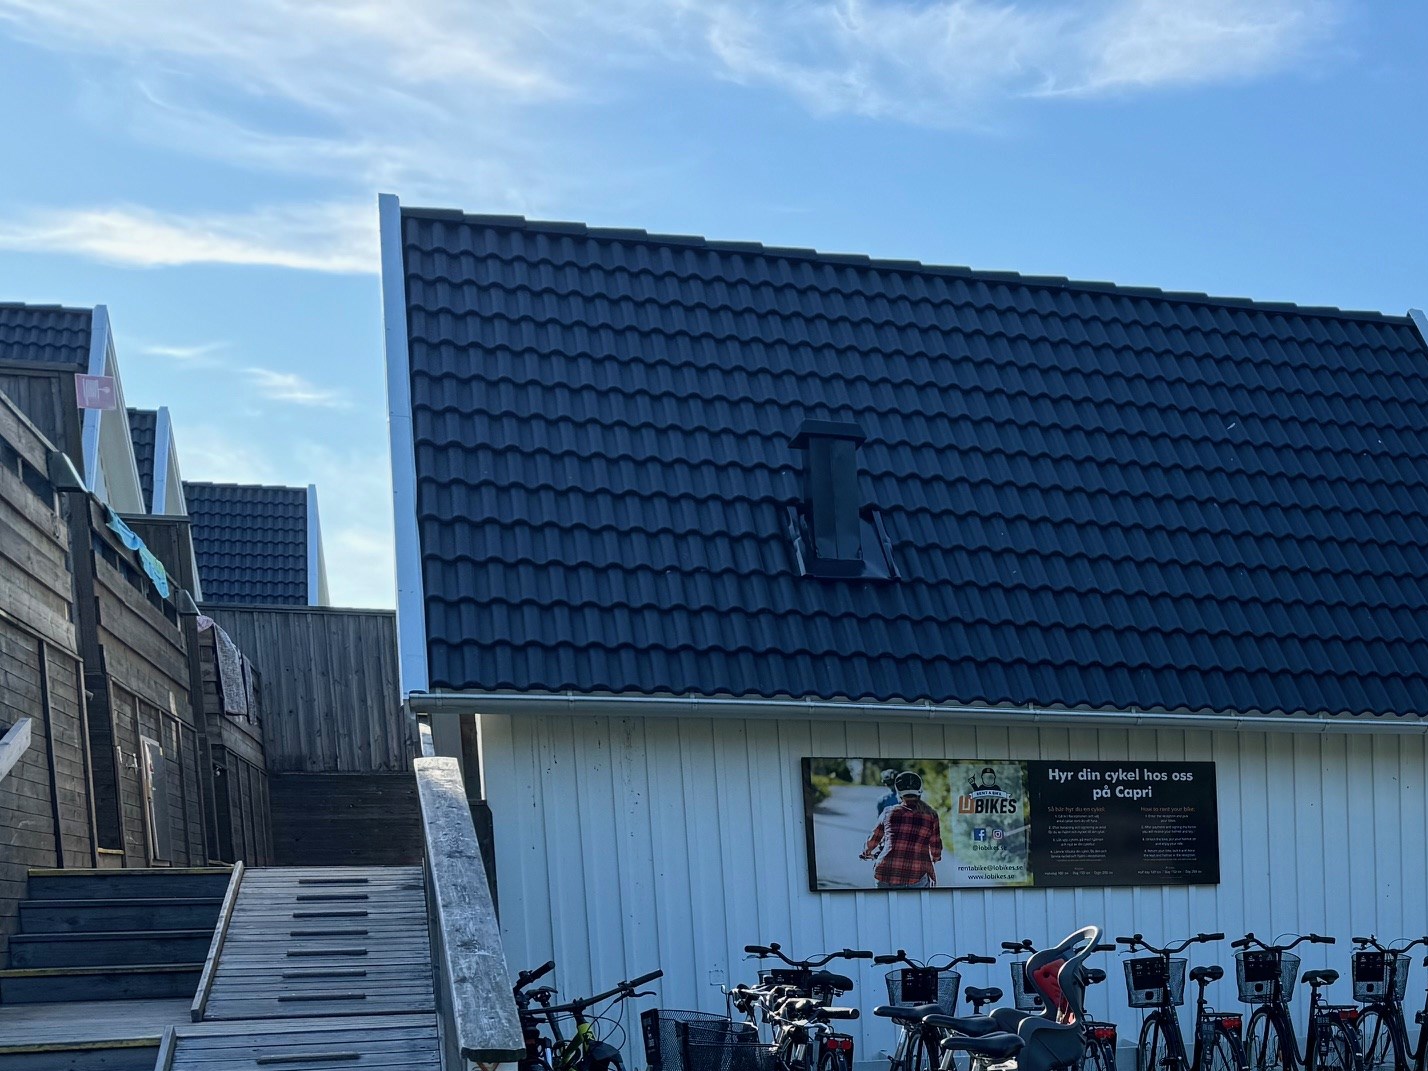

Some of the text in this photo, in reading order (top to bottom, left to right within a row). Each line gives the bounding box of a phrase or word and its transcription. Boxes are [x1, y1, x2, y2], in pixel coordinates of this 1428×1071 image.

[1048, 768, 1194, 783] Hyr din cykel hos oss
[1093, 785, 1152, 800] på Capri
